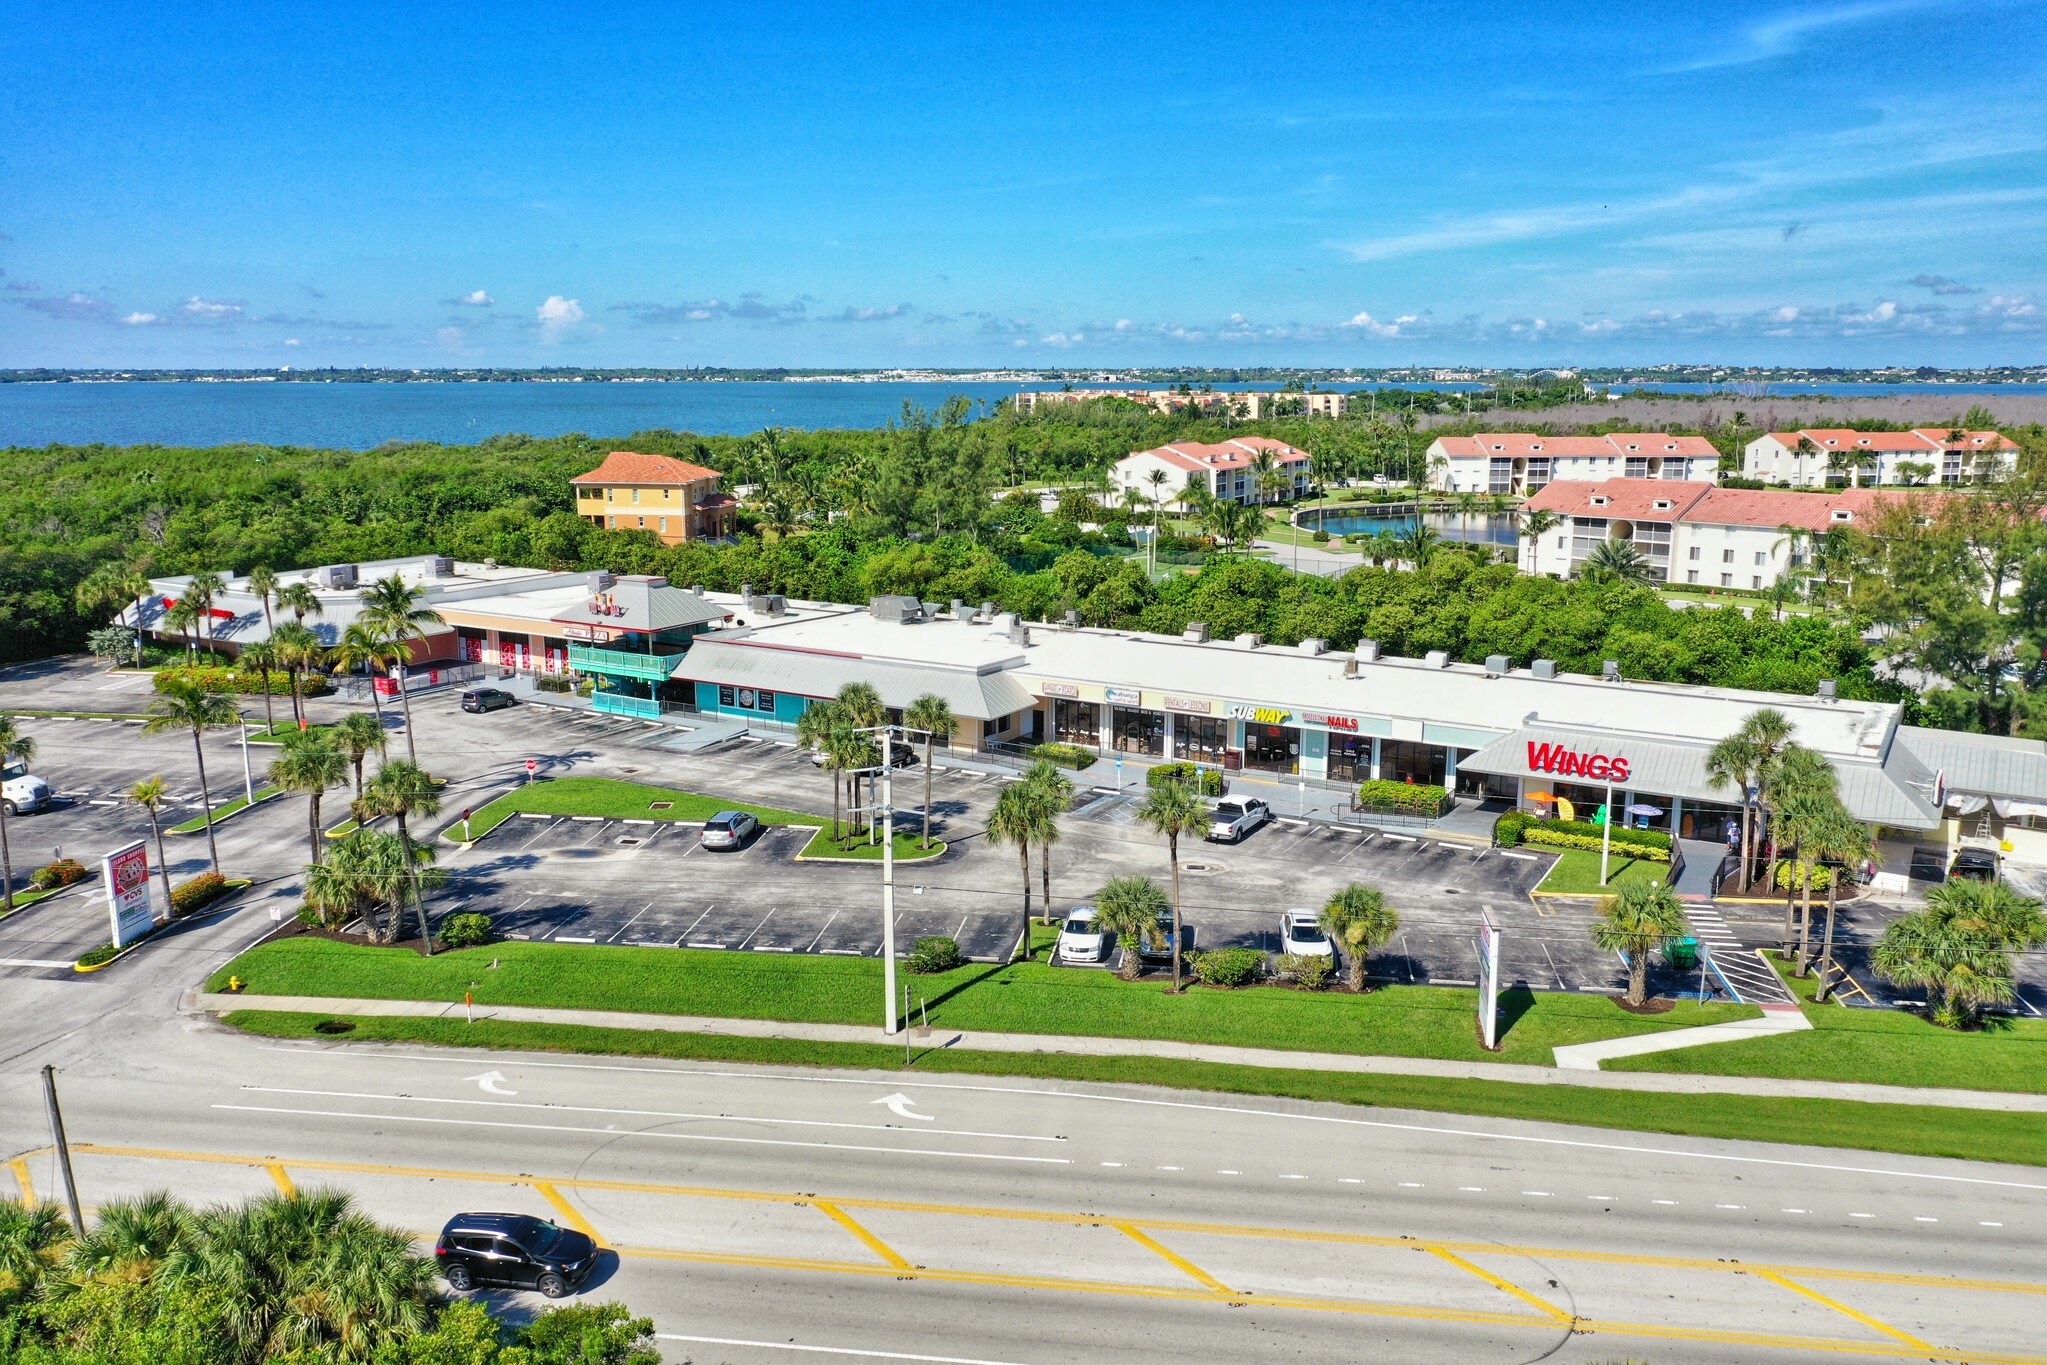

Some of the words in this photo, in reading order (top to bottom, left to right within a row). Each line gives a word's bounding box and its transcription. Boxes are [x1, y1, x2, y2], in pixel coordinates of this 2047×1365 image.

[1165, 697, 1184, 708] RENTALS
[1189, 700, 1208, 711] LESSONS
[1229, 705, 1292, 724] SUBWAY
[1327, 715, 1358, 729] NAILS
[1527, 740, 1629, 783] WINGS
[111, 856, 127, 868] ISLAND
[130, 888, 143, 899] CVS
